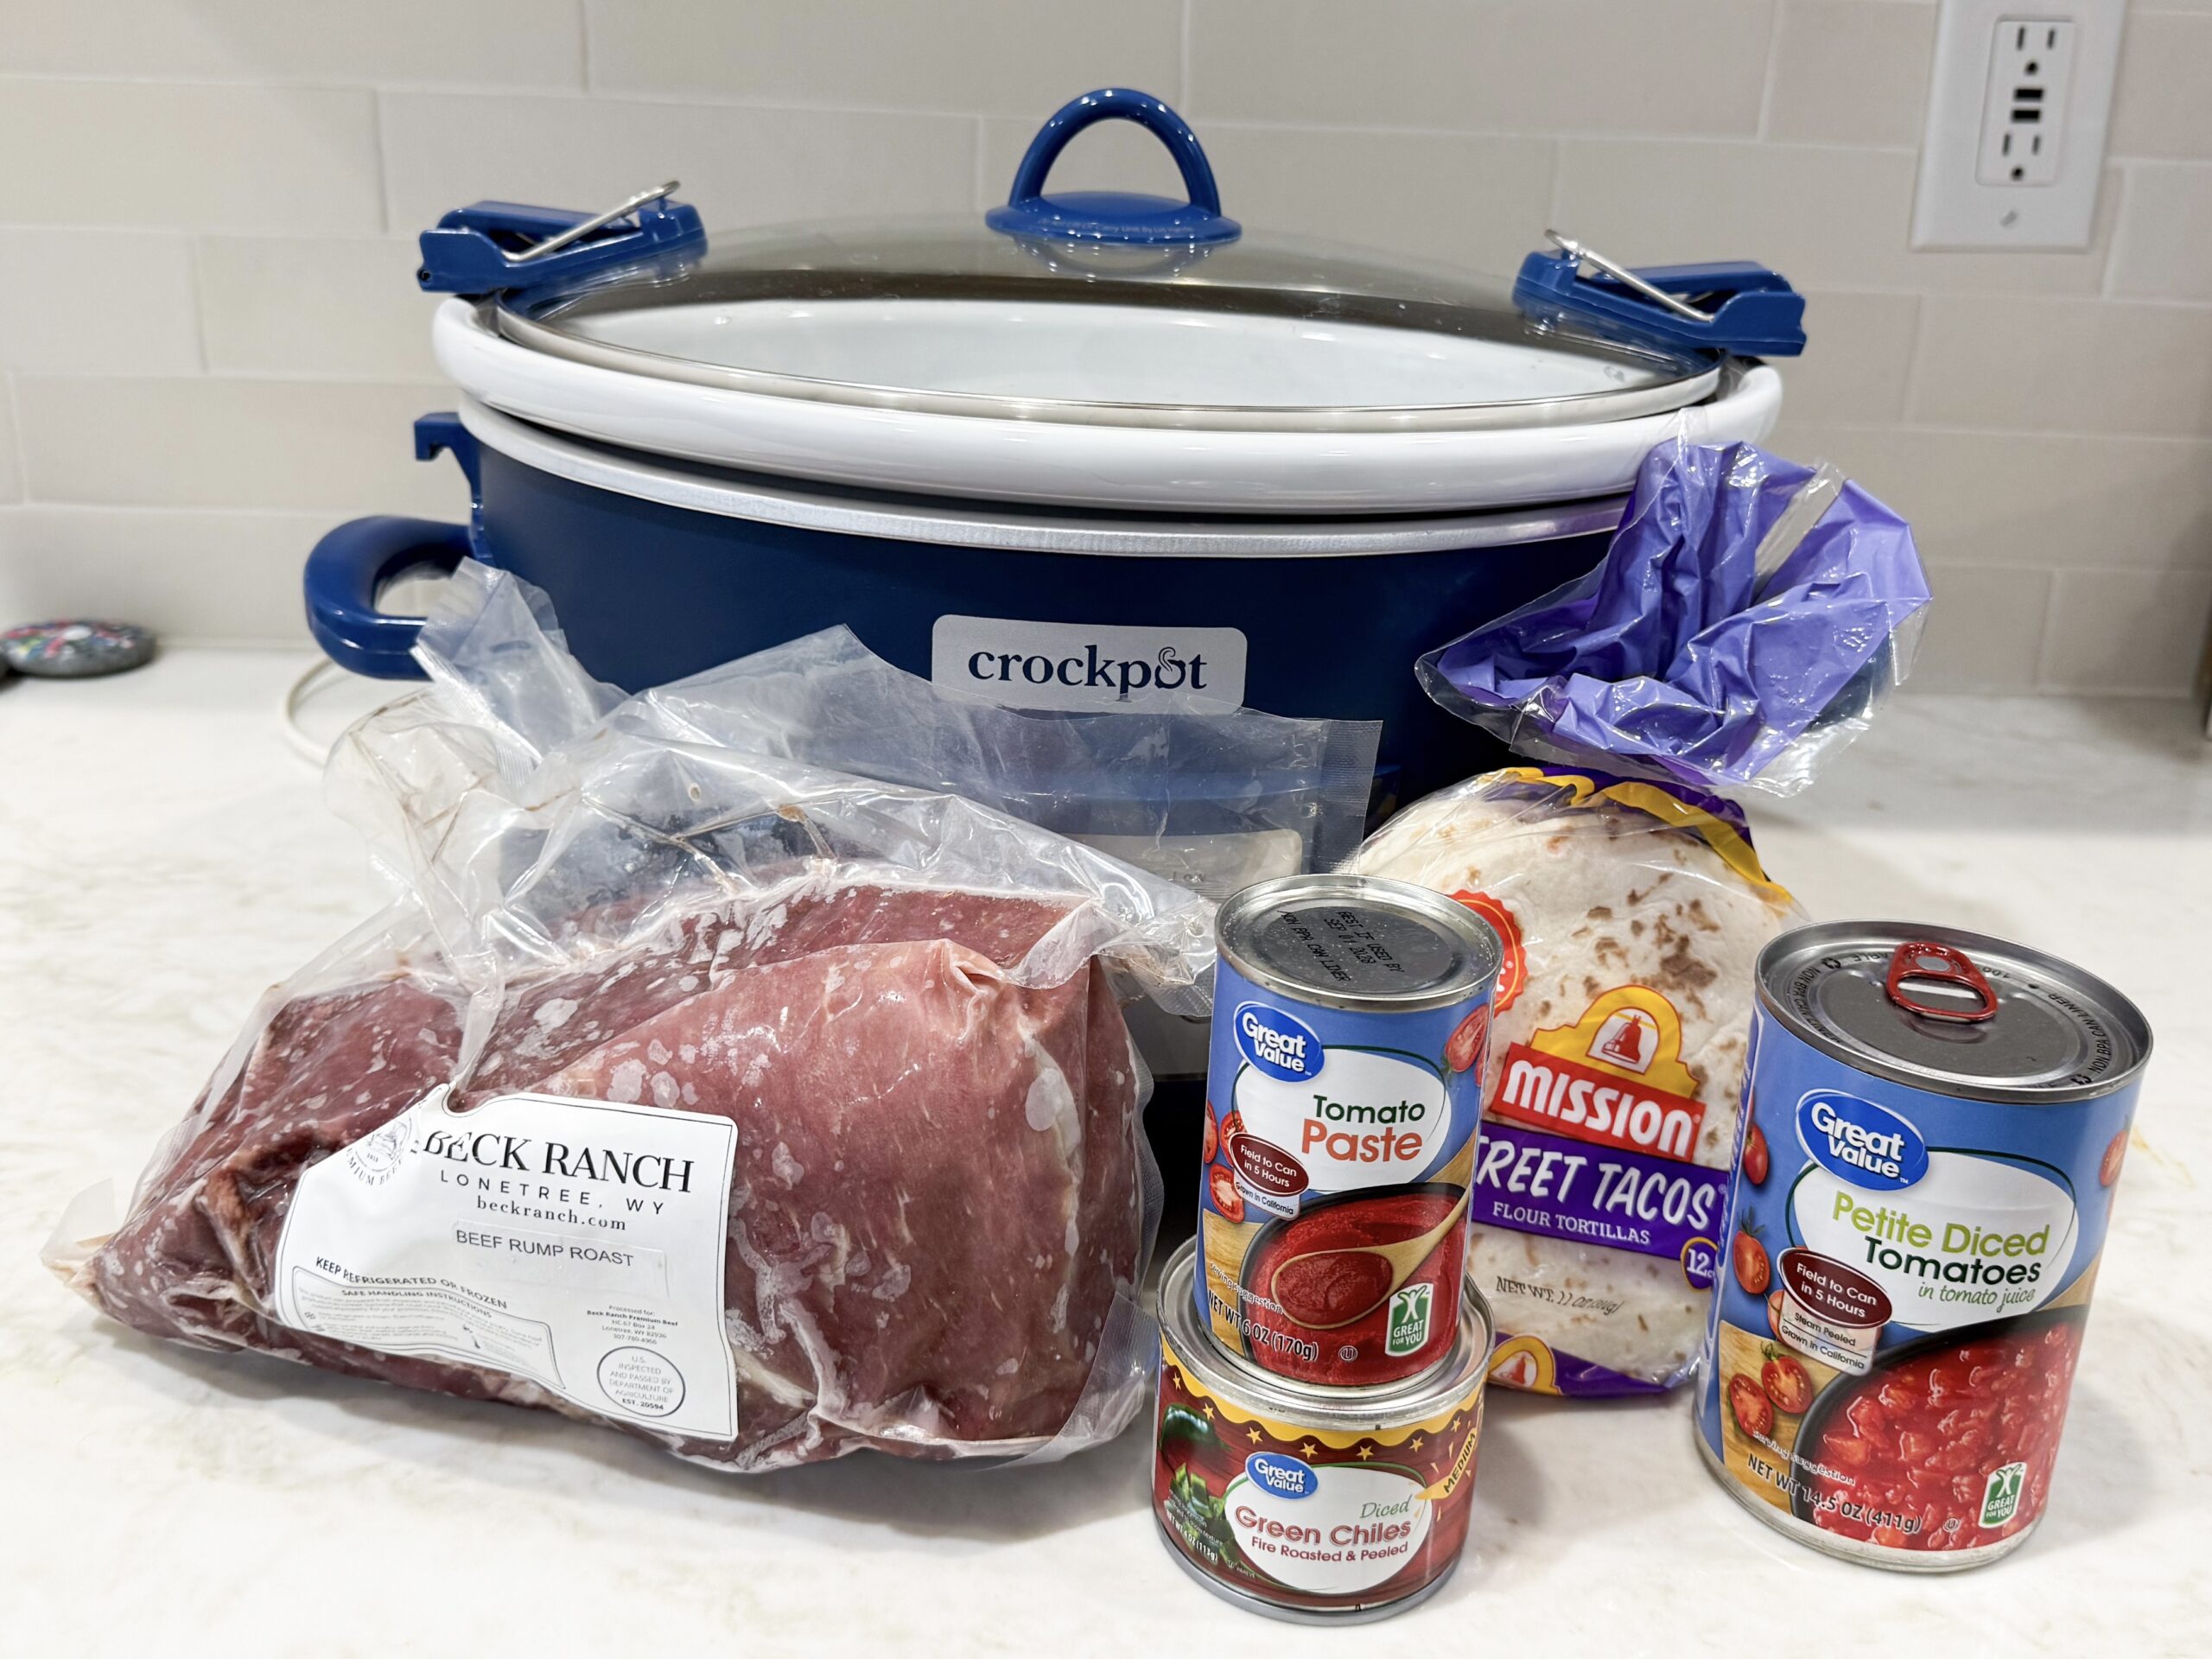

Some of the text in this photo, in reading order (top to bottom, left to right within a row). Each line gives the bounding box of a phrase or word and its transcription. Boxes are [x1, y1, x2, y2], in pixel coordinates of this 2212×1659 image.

[968, 645, 1207, 702] crockpot
[2048, 993, 2089, 1019] LINER
[1243, 1012, 1306, 1058] Great
[2096, 1038, 2112, 1056] BPA
[1254, 1039, 1305, 1072] Value
[2088, 1054, 2110, 1073] NON
[1313, 1094, 1426, 1124] Tomato
[1301, 1118, 1422, 1163] Paste
[1811, 1102, 1904, 1162] Great
[422, 1130, 695, 1193] BECK RANCH
[1241, 1144, 1297, 1177] Field to Can
[1244, 1160, 1290, 1187] in 5 Hours
[1827, 1135, 1900, 1179] Value
[441, 1170, 664, 1215] LONETREE, WY
[1236, 1181, 1254, 1197] Grown
[1262, 1197, 1294, 1215] California
[1476, 1135, 1587, 1204] REET
[1592, 1163, 1716, 1230] TACOS
[477, 1195, 626, 1231] beckranch.com
[1492, 1201, 1651, 1245] FLOUR TORTILLAS
[1833, 1191, 2050, 1257] Petite Diced
[456, 1230, 634, 1267] BEEF RUMP ROAST
[1865, 1236, 2041, 1286] Tomatoes
[316, 1256, 341, 1275] KEEP
[343, 1268, 437, 1285] REFRIGERATED
[441, 1279, 457, 1288] OR
[461, 1286, 507, 1309] FROZEN
[1233, 1283, 1284, 1315] suggestion
[1496, 1276, 1526, 1294] NET
[1529, 1285, 1554, 1303] WT.
[1796, 1262, 1877, 1306] Field to Can
[1918, 1282, 2036, 1313] in tomato juice
[426, 1291, 493, 1318] INSTRUCTIONS
[1801, 1281, 1866, 1318] in 5 Hours
[629, 1314, 661, 1324] Premium
[1209, 1289, 1319, 1362] NET WT 6 OZ (170g)
[1394, 1319, 1424, 1338] GREAT
[1795, 1313, 1856, 1347] Steam Peeled
[1393, 1332, 1422, 1346] FOR YOU
[1782, 1325, 1808, 1346] Grown
[1820, 1346, 1865, 1369] California
[609, 1378, 660, 1392] DEPARTMENT
[610, 1370, 627, 1379] AND
[629, 1373, 659, 1383] PASSED
[619, 1363, 661, 1375] INSPECTED
[615, 1389, 668, 1403] AGRICULTURE
[1255, 1459, 1306, 1484] Great
[1444, 1433, 1475, 1494] MEDIUM
[1752, 1430, 1856, 1487] serving suggestion
[1265, 1473, 1304, 1493] Value
[1747, 1452, 1923, 1535] NET WT 14.5 OZ (411g)
[1360, 1494, 1413, 1519] Diced
[1988, 1495, 2015, 1511] GREAT
[1997, 1505, 2012, 1518] YOU
[1234, 1505, 1321, 1545] Green
[1329, 1521, 1412, 1547] Chiles
[1251, 1536, 1408, 1562] Fire Roasted & Peeled
